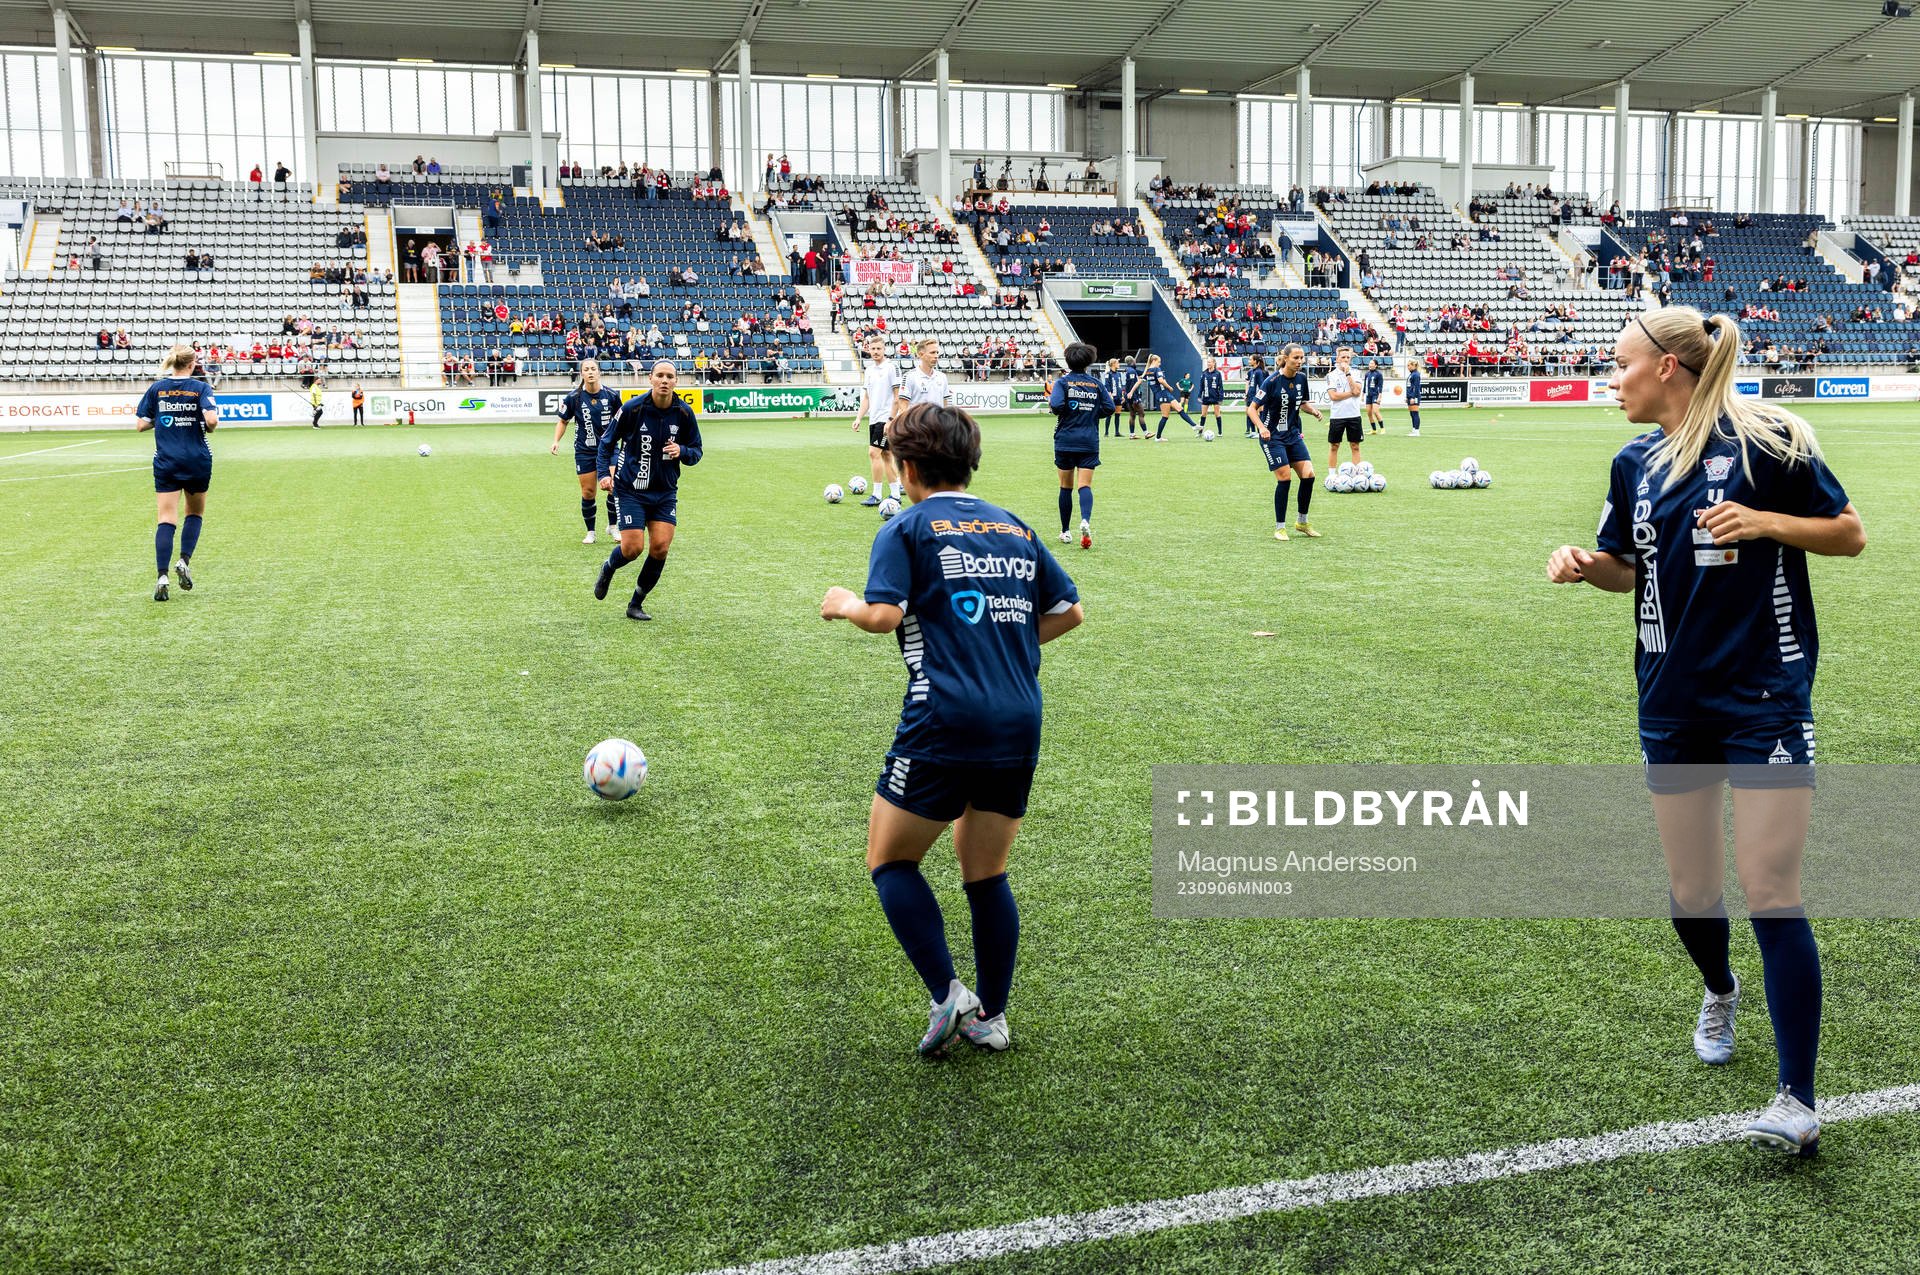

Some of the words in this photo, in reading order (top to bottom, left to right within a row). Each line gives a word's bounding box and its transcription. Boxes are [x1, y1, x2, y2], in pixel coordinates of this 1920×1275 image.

[855, 262, 881, 272] ARSENAL
[892, 263, 913, 273] WOMEN
[1819, 380, 1867, 395] Corren
[394, 399, 446, 412] PacsOn
[728, 391, 814, 407] nolltretton
[956, 392, 1008, 408] Botrygg
[9, 405, 80, 417] BORGATE
[214, 403, 269, 418] rren
[637, 434, 652, 479] Botrygg
[624, 514, 632, 524] 10
[930, 518, 1032, 541] BILBÖRSEN
[962, 552, 1036, 582] Botrygg
[985, 594, 1033, 613] Tekniska
[990, 609, 1027, 625] verken
[1768, 756, 1793, 764] SELECT
